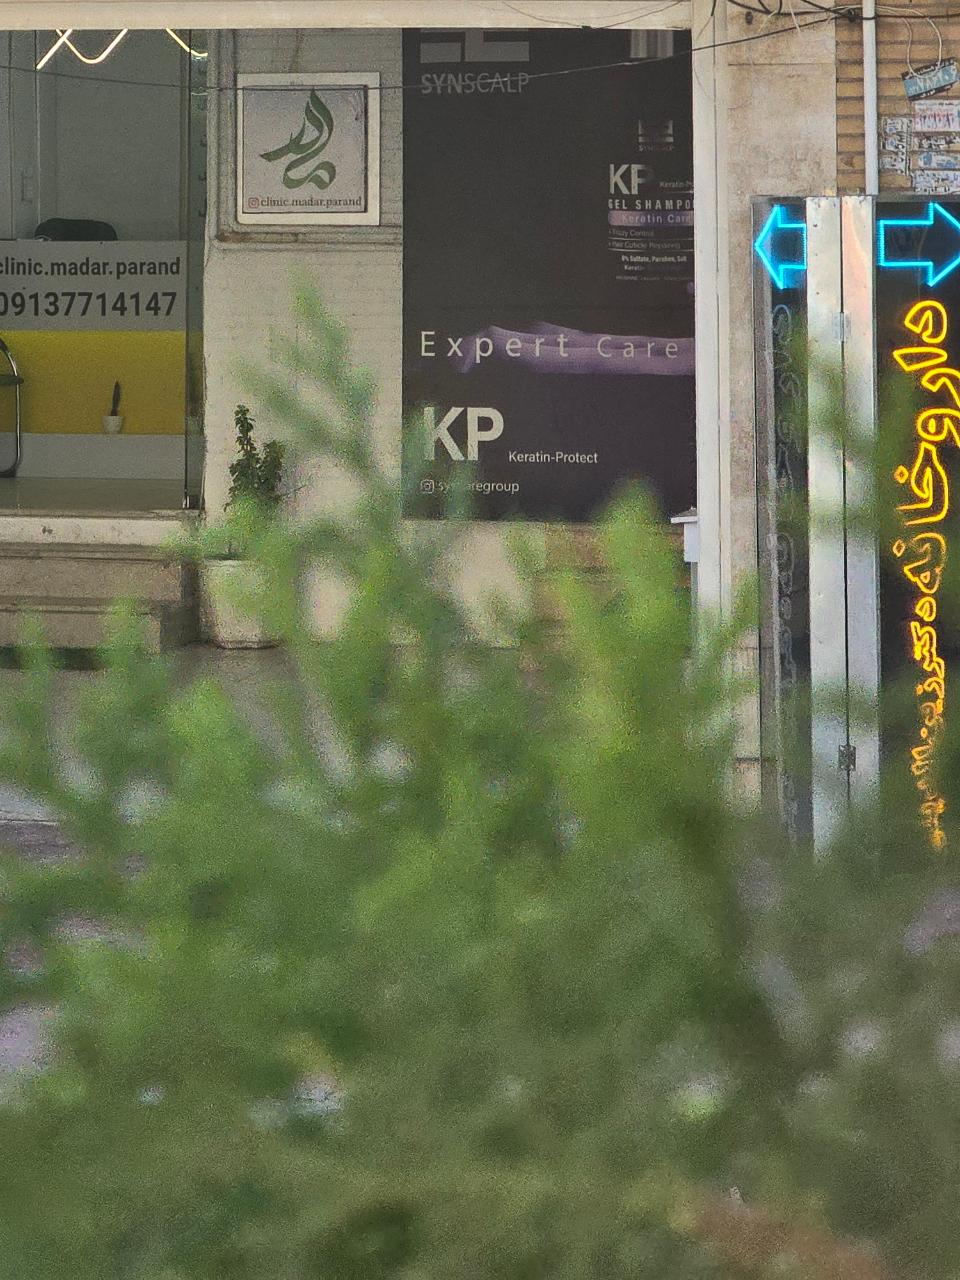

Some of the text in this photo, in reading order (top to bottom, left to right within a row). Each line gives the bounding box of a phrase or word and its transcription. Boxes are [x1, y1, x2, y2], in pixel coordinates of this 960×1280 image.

[420, 72, 530, 95] SYNSCALP
[608, 199, 694, 210] GEL SHAMPO
[420, 331, 679, 363] Expert Care
[423, 406, 505, 461] KP
[508, 451, 599, 464] Keratin-Protect
